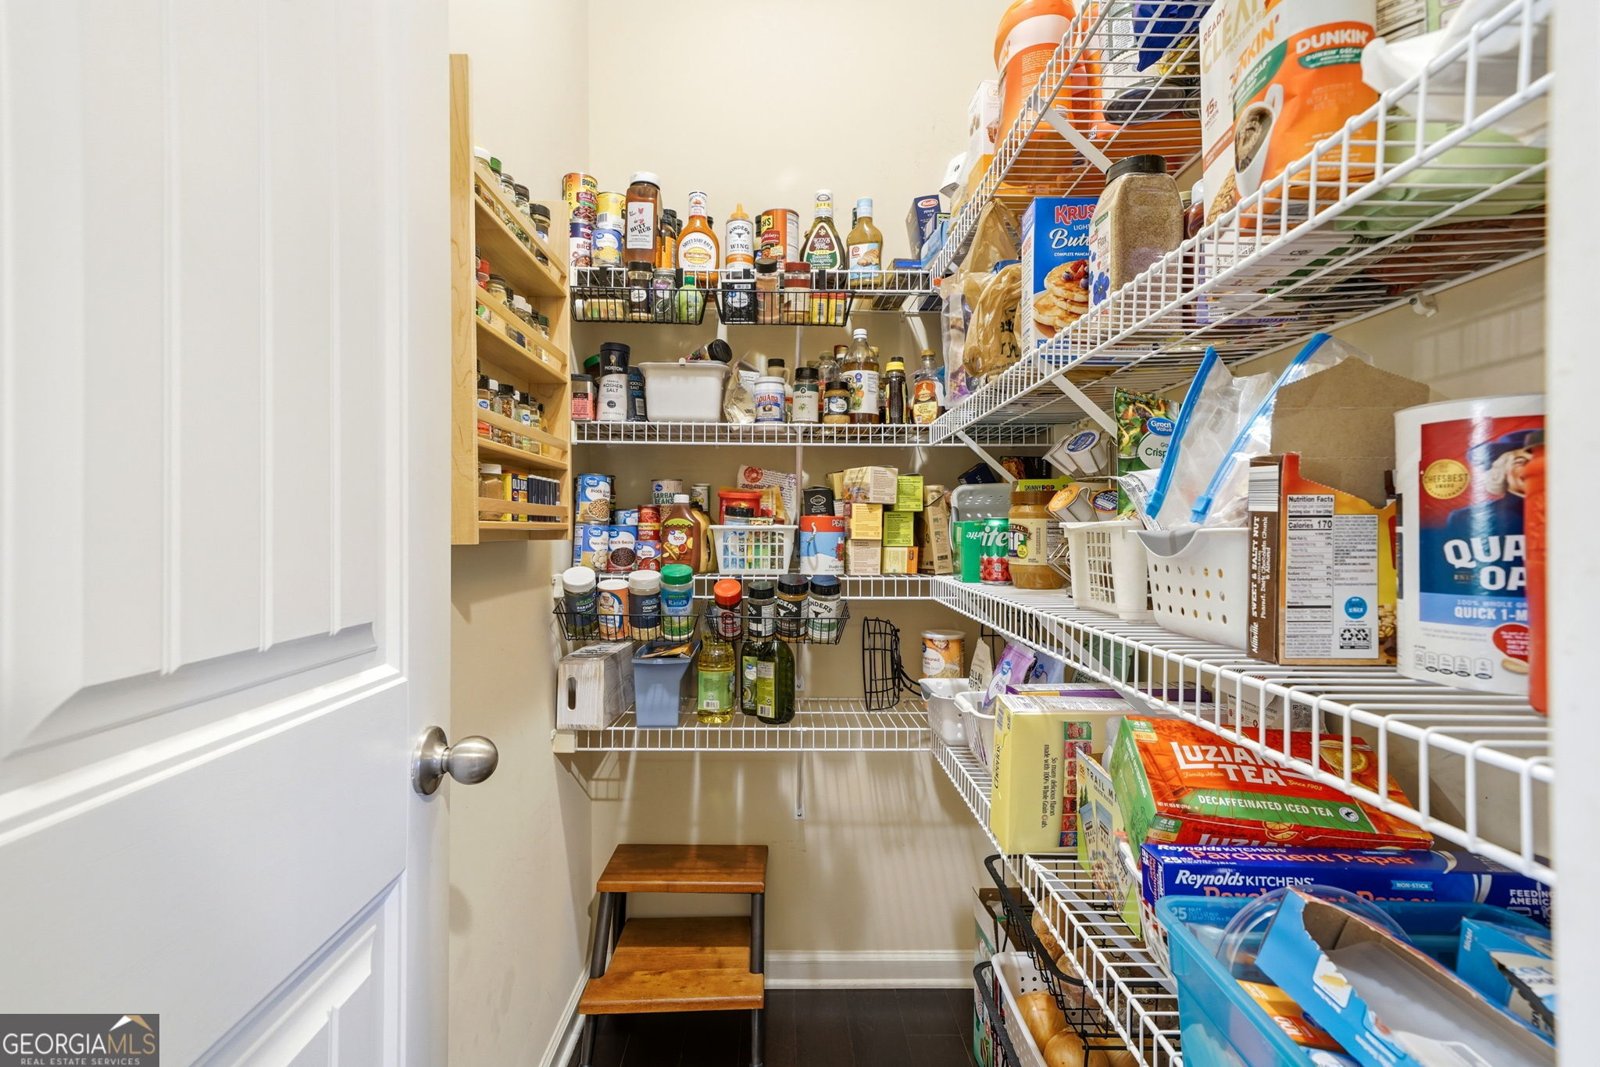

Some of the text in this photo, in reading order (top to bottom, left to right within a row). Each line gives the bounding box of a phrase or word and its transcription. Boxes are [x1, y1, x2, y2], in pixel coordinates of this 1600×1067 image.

[1203, 5, 1227, 45] READY
[1150, 420, 1173, 429] Great
[1424, 473, 1468, 483] CHEFSBEST
[1317, 520, 1333, 529] 170
[1454, 606, 1497, 620] QUICK
[1086, 767, 1106, 793] TRAIL
[1218, 763, 1288, 787] TEA
[1198, 795, 1282, 811] DECAFFEINATED
[1284, 803, 1310, 815] ICED
[1311, 806, 1334, 818] TEA
[1157, 844, 1222, 852] Reynolds
[1187, 850, 1415, 865] Parchment Paper
[1175, 869, 1245, 889] Reynolds
[1395, 881, 1429, 889] NON-STICK
